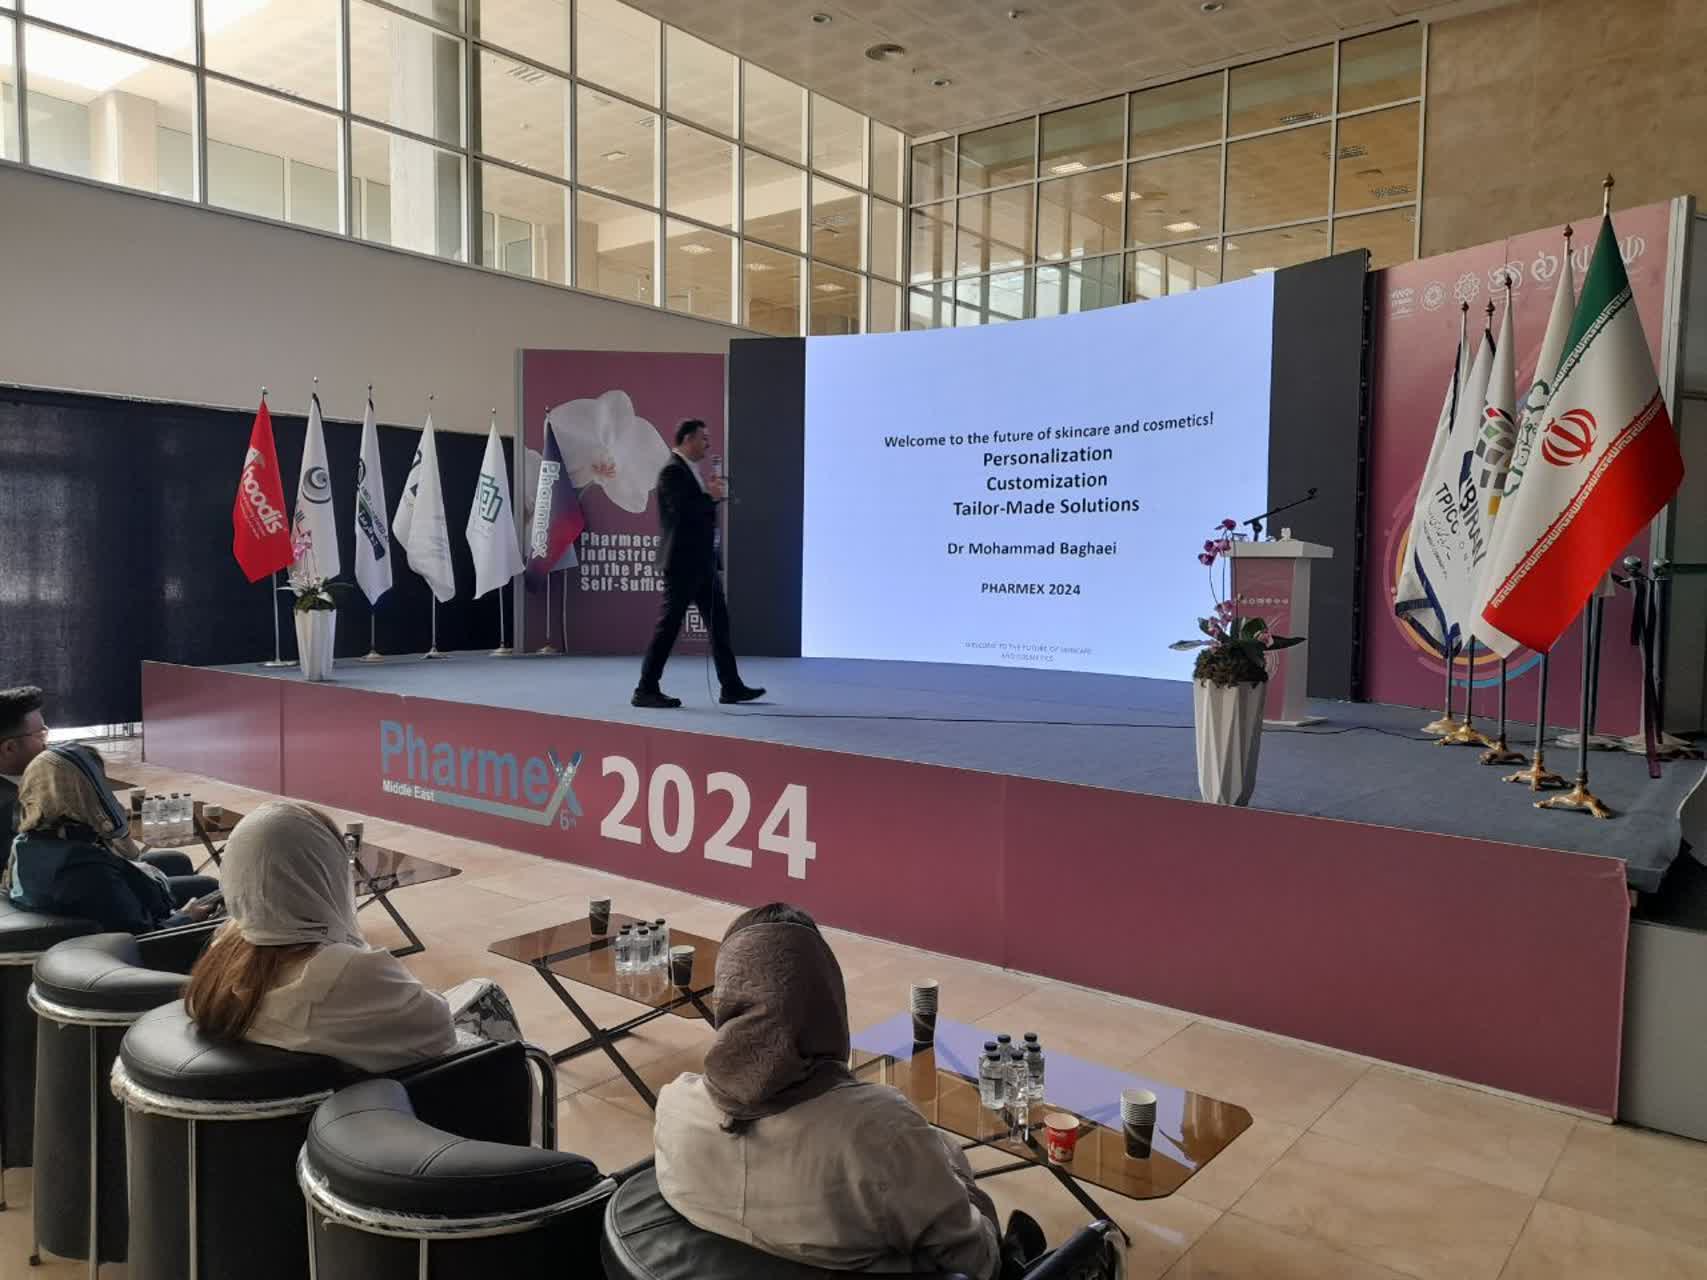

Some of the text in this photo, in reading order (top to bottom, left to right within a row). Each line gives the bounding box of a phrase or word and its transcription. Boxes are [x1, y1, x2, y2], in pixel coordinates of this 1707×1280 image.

[884, 410, 1214, 448] Welcome to the future of skincare and cosmetics!
[983, 446, 1113, 467] Personalization
[986, 471, 1108, 492] Customization
[952, 496, 1140, 516] Tailor-Made Solutions
[947, 541, 1117, 559] Dr Mohammad Baghaei
[581, 564, 600, 576] on
[604, 563, 630, 576] the
[981, 582, 1081, 596] PHARMEX 2024
[382, 777, 435, 802] Middle East
[601, 755, 817, 880] 2024
